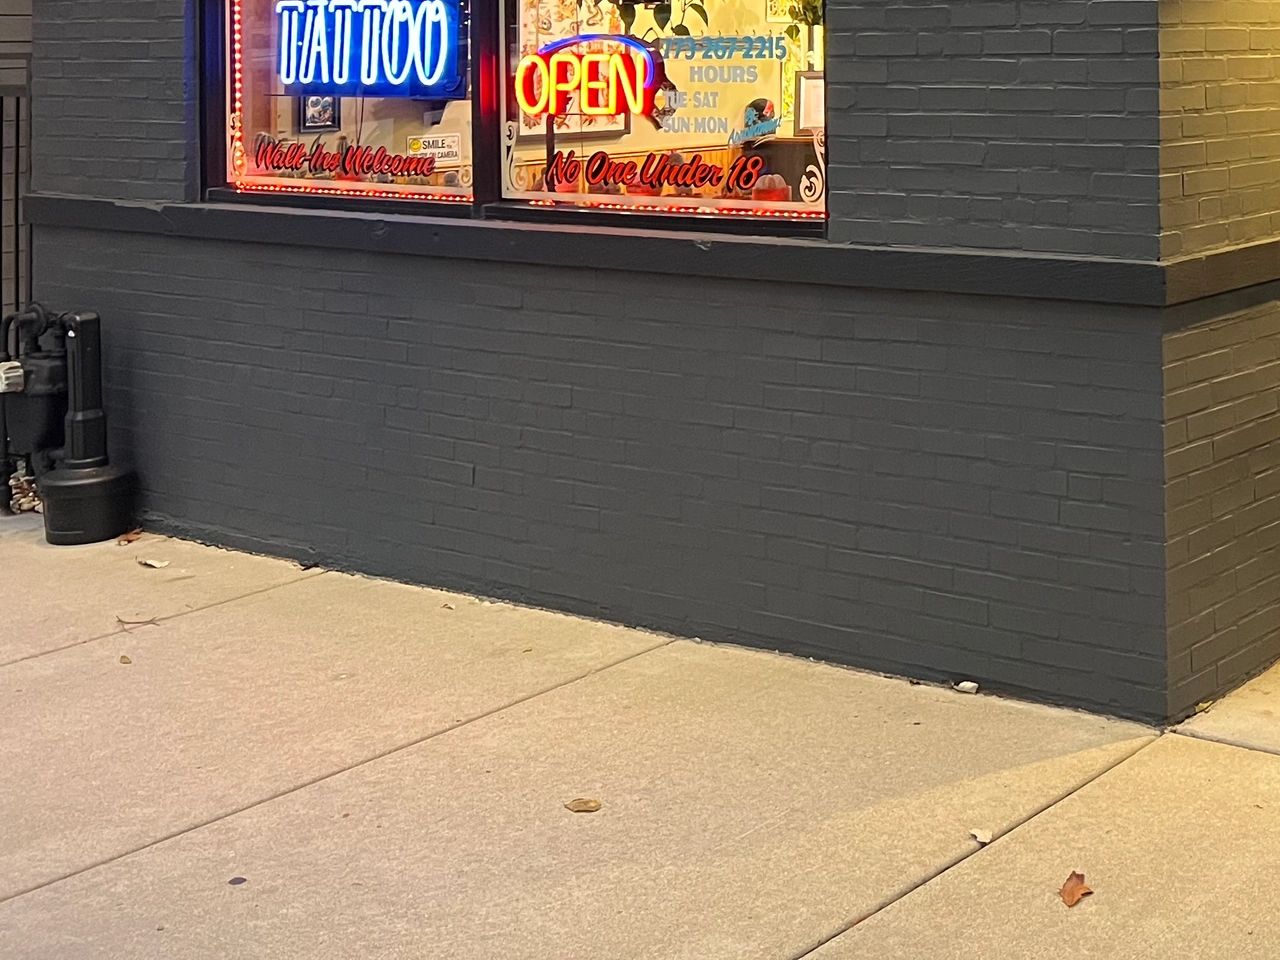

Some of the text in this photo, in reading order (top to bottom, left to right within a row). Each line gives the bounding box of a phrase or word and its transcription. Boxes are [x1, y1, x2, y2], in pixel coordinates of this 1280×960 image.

[276, 0, 447, 85] TATTOO
[514, 52, 646, 116] OPEN
[689, 65, 758, 83] HOURS
[255, 141, 436, 177] Walk-Ins Welcome
[422, 139, 446, 150] SMILE
[546, 150, 765, 192] No One Under 18
